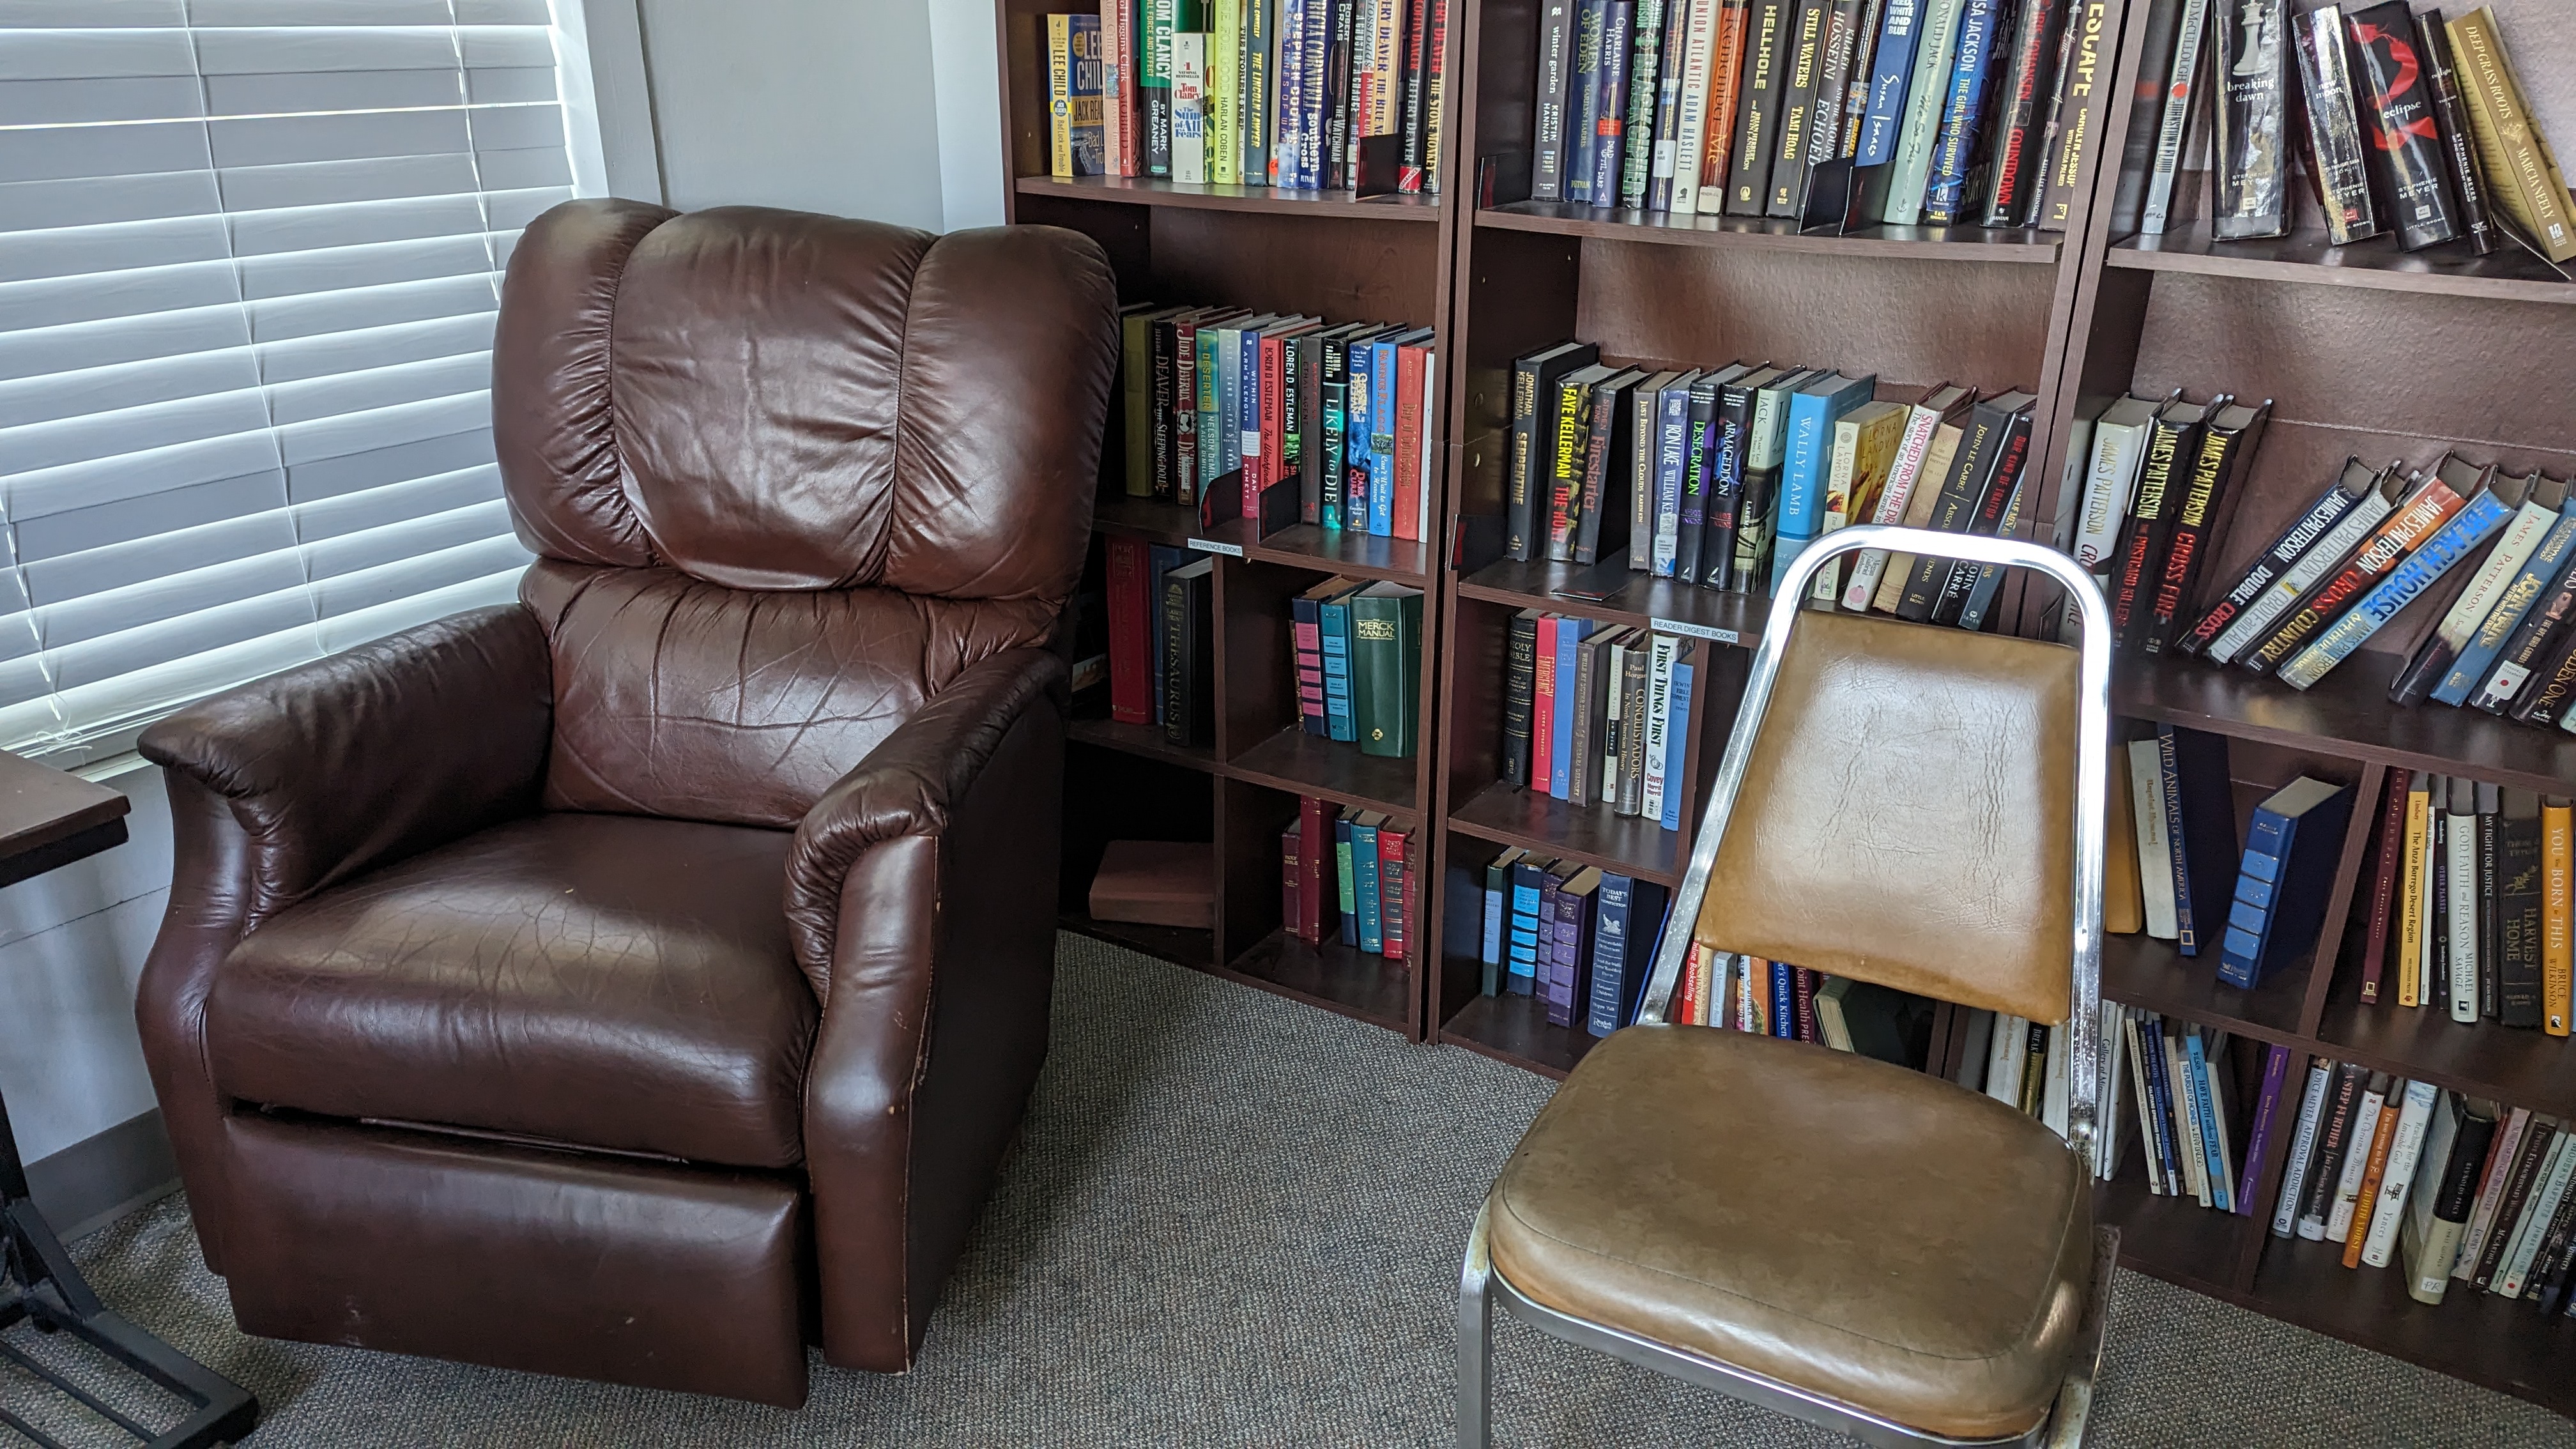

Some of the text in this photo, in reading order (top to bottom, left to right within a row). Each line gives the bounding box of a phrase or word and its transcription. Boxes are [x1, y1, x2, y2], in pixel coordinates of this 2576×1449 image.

[1337, 4, 1346, 42] CRAIS
[1888, 17, 1911, 26] AND
[1889, 6, 1913, 16] WHITE
[1586, 11, 1602, 72] WOMEN
[1604, 28, 1615, 66] HARRIS
[1612, 17, 1627, 77] CHARLAINE
[1754, 5, 1777, 89] HELLHOLE
[1795, 8, 1821, 88] STILL WATERS
[1823, 10, 1846, 81] HOSSEINI
[1841, 27, 1855, 70] KHALED
[1887, 26, 1907, 36] BLUE
[2073, 3, 2105, 97] ESCAPE
[1054, 50, 1066, 66] LEE
[1156, 27, 1170, 79] CLANCY
[1549, 26, 1562, 94] winter garden
[1926, 43, 1941, 70] JACK
[1054, 68, 1066, 96] CHILD
[1181, 83, 1197, 93] Tom
[1679, 1, 1709, 172] UNION ATLANTIC ADAM HASLETT
[2227, 77, 2275, 94] breaking
[2318, 79, 2337, 90] new
[2465, 26, 2513, 120] DEEP GRASS ROOTS
[1174, 89, 1200, 102] Clancy
[1942, 18, 1983, 177] JACKSON THE GIRL WHO SURVIVED
[2235, 91, 2264, 103] dawn
[2315, 86, 2343, 100] moon
[2383, 99, 2422, 120] eclipse
[1174, 109, 1200, 120] Sum
[1220, 97, 1229, 130] HARLAN
[1542, 103, 1550, 142] HANNAH
[1551, 105, 1559, 141] KRISTIN
[1808, 98, 1830, 167] ECHOED
[1175, 129, 1201, 139] Fears
[1784, 107, 1804, 160] TAMI HOAG
[1997, 128, 2025, 204] COUNTDOWN
[2398, 178, 2438, 192] STEPHENIE
[2516, 147, 2556, 220] MARCIA NEELY
[2328, 188, 2365, 202] MEYER
[2399, 183, 2439, 199] MEYER
[1325, 345, 1333, 378] FAIRSTEIN
[1333, 353, 1341, 372] LINDA
[1155, 356, 1169, 407] DEAVER
[1202, 353, 1211, 410] DESERTER
[1515, 371, 1525, 420] KELLERMAN
[1524, 371, 1535, 415] JONATHAN
[1758, 397, 1770, 424] JACK
[1912, 412, 1922, 427] The
[1324, 398, 1338, 503] LIKELY to DIE
[1556, 388, 1577, 479] FAYE KELLERMAN
[1903, 425, 1914, 441] story
[1513, 431, 1528, 505] SERPENTINE
[1583, 434, 1606, 512] Firestarter
[1688, 420, 1706, 496] DESECRATION
[1719, 420, 1736, 497] ARMAGEDDON
[1790, 417, 1812, 516] WALLY LAMB
[1832, 446, 1845, 489] LANDVIK
[1841, 452, 1853, 486] LORNA
[2136, 425, 2179, 520] JAMES PATTERSON
[1887, 463, 1903, 494] American
[2181, 431, 2228, 528] JAMES PATTERSON
[1551, 487, 1570, 541] THE HUNT
[1878, 493, 1891, 515] family
[1190, 540, 1241, 554] REFERENCE BOOKS
[2465, 510, 2541, 613] JAMES PATTERSON
[2195, 564, 2274, 640] DOUBLE CROSS
[2255, 589, 2289, 625] CRADLE
[2312, 570, 2361, 616] CROSS
[2362, 560, 2432, 622] HOUSE
[1358, 622, 1394, 631] MERCK
[1358, 629, 1394, 638] MANUAL
[1653, 620, 1736, 640] READER DIGEST BOOKS
[2258, 608, 2320, 663] COUNTRY
[1510, 641, 1531, 652] HOLY
[1625, 670, 1647, 680] Horgan
[1650, 643, 1671, 747] FIRST THINGS FIRST
[1630, 689, 1645, 779] CONQUISTADORS
[1646, 773, 1663, 785] Covey
[2160, 733, 2186, 900] WILD ANIMALS NORTH AMERICA
[2413, 831, 2421, 845] The
[2458, 825, 2470, 852] GOD,
[2409, 897, 2418, 918] Desert
[2550, 828, 2563, 949] YOU BORN THIS
[2407, 919, 2417, 944] Region
[2458, 900, 2469, 949] REASON
[2507, 919, 2520, 962] HOME
[1685, 962, 1697, 1002] Bookselling
[1777, 978, 1788, 1002] Quick
[2455, 956, 2464, 988] SAVAGE
[2465, 953, 2473, 993] MICHAEL
[2549, 958, 2557, 1008] WILKINSON
[2557, 968, 2566, 999] BRUCE
[2198, 1080, 2207, 1098] HAVE
[2203, 1098, 2212, 1119] FAITH
[2209, 1140, 2218, 1158] FEAR
[2285, 1070, 2323, 1213] JOYCE MEYER APPROVAL ADDICTION
[2425, 1281, 2441, 1291] PR
